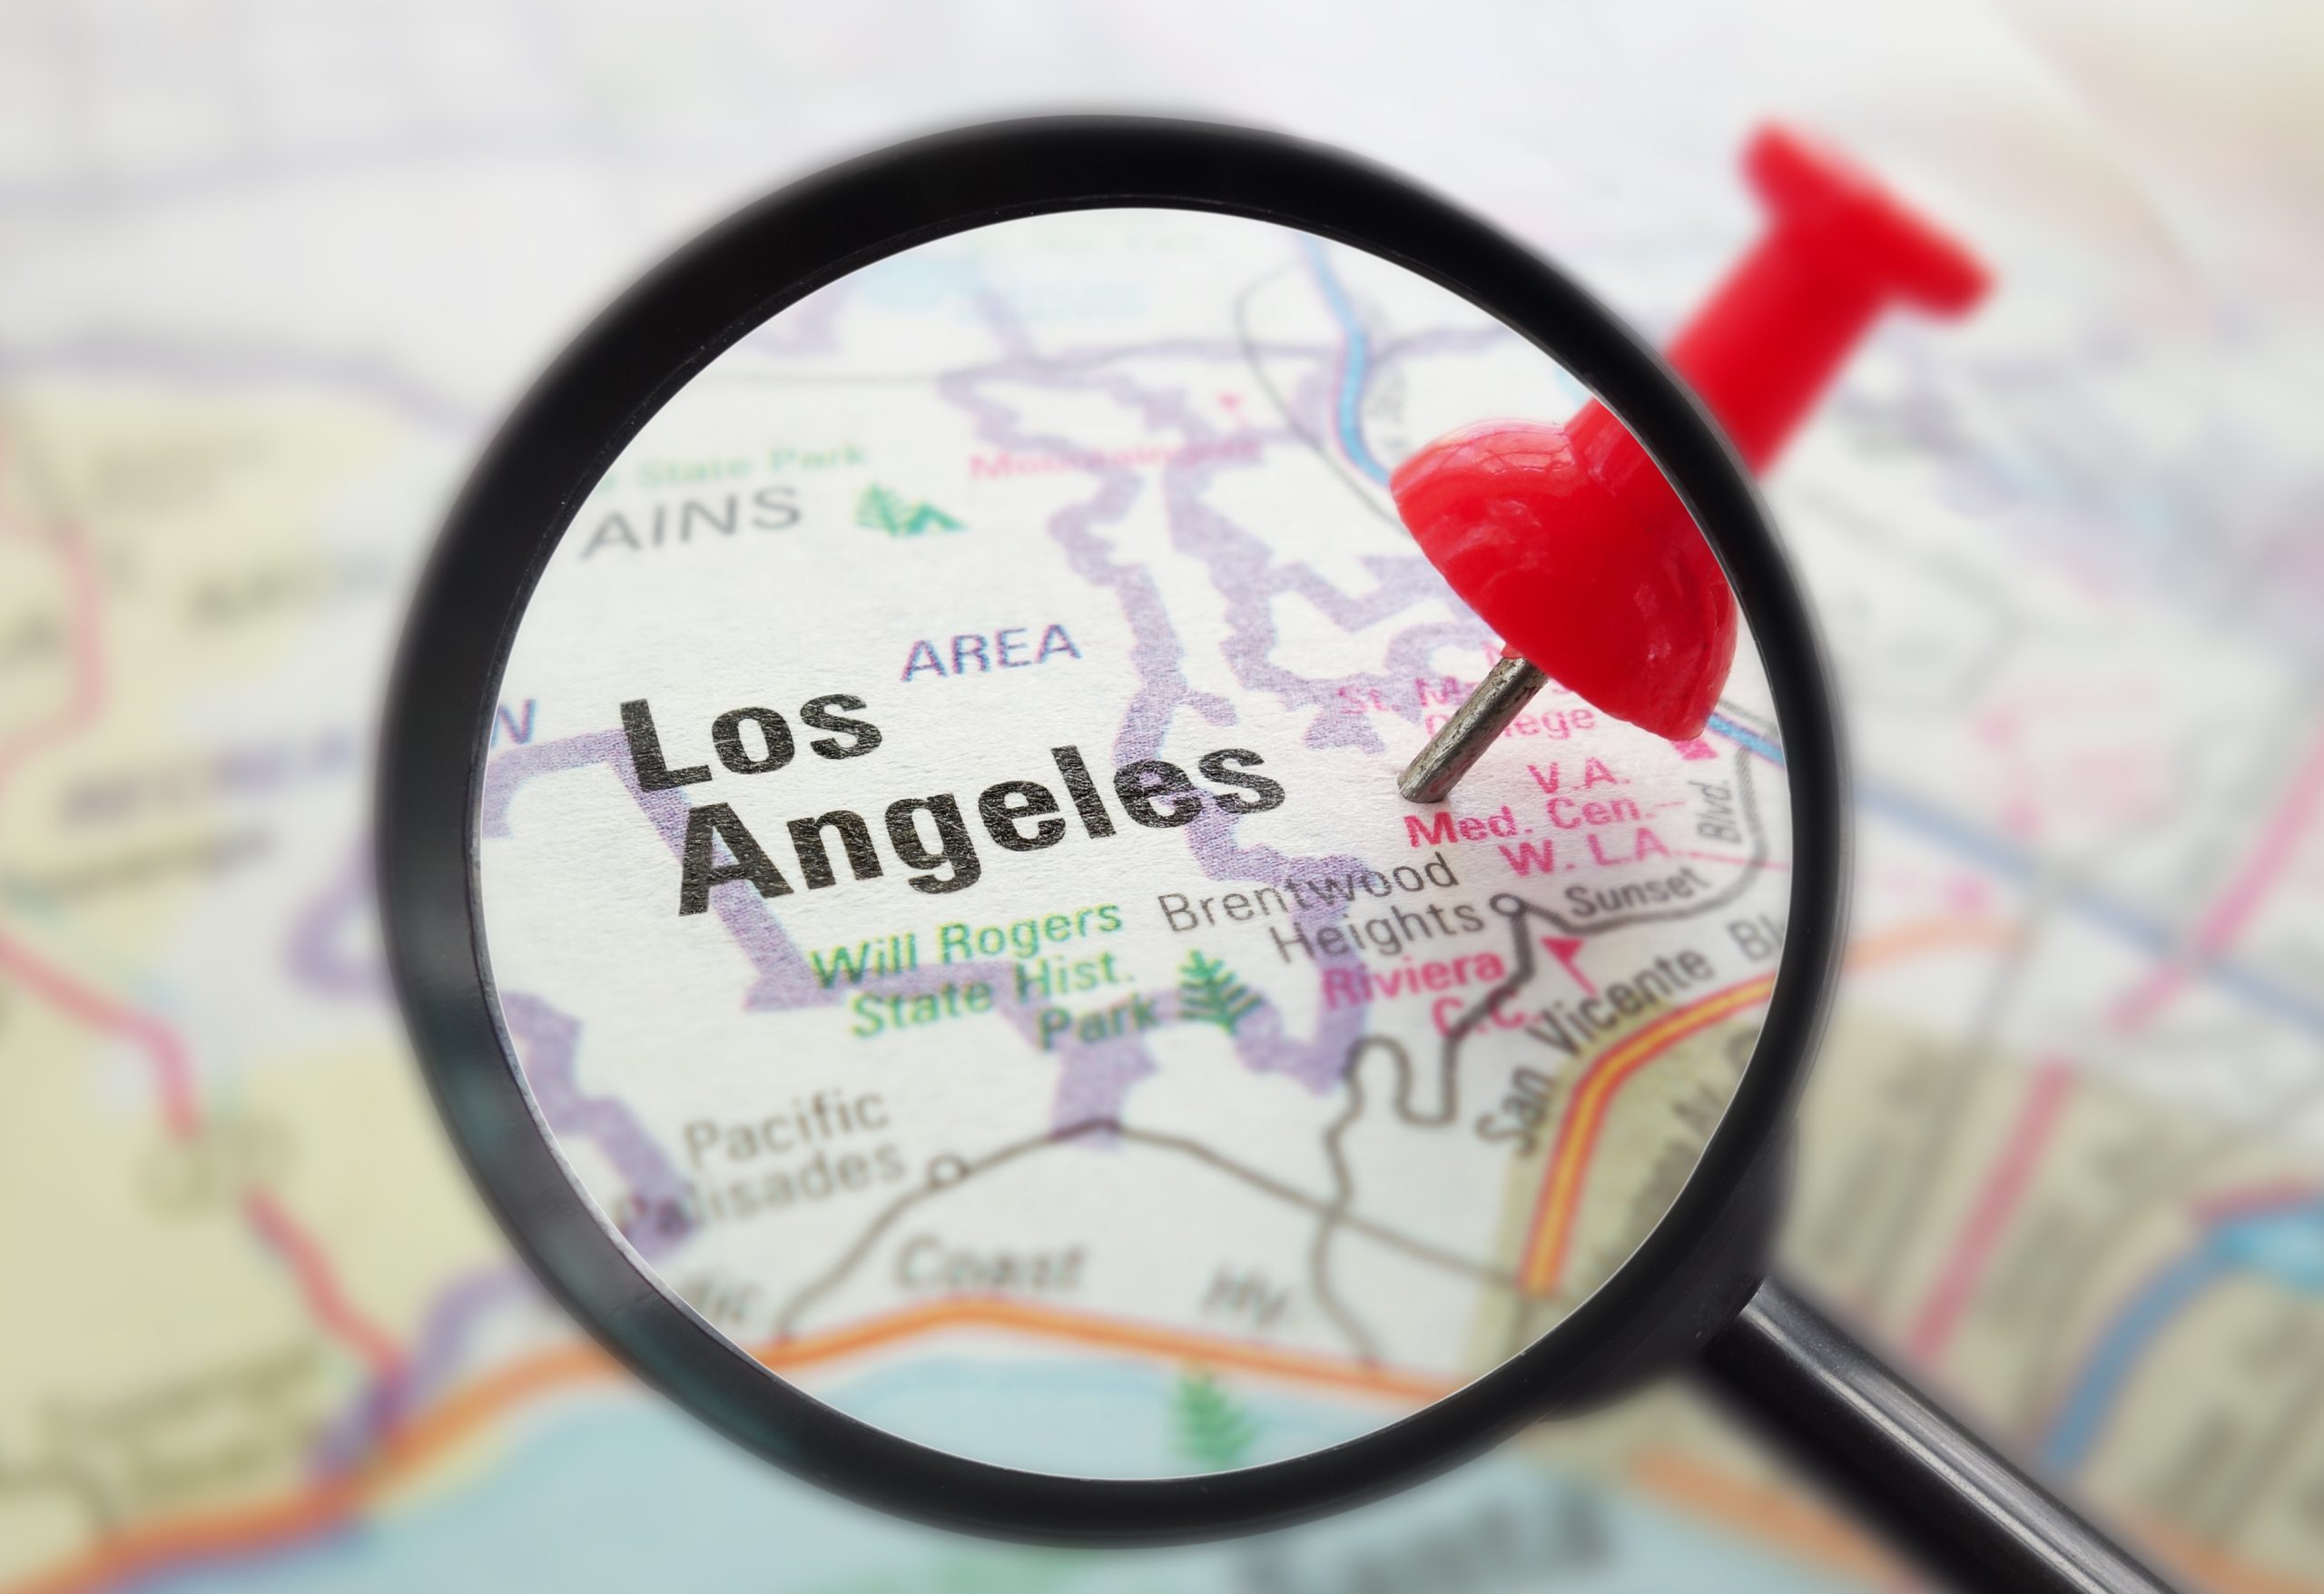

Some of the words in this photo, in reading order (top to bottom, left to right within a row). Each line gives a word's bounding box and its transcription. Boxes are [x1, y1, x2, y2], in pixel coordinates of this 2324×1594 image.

[769, 443, 866, 471] Park
[901, 624, 1082, 682] AREA
[619, 694, 882, 792] Los
[677, 744, 1287, 917] Angeles
[1403, 804, 1533, 848] Med.
[1546, 795, 1656, 830] Cen.
[1499, 839, 1574, 878] W.
[1158, 851, 1460, 933] Brentwood
[1564, 867, 1714, 918] Sunset
[809, 933, 918, 991] Will
[936, 903, 1123, 965] Rogers
[1269, 903, 1486, 964] Heights
[849, 981, 996, 1038] State
[1014, 950, 1136, 1001] Hist.
[1321, 950, 1508, 1012] Riviera
[1039, 993, 1157, 1055] Park
[1474, 1064, 1554, 1158] San
[1525, 948, 1716, 1058] Vicente
[683, 1088, 891, 1171] Pacific
[893, 1232, 1088, 1293] Coast
